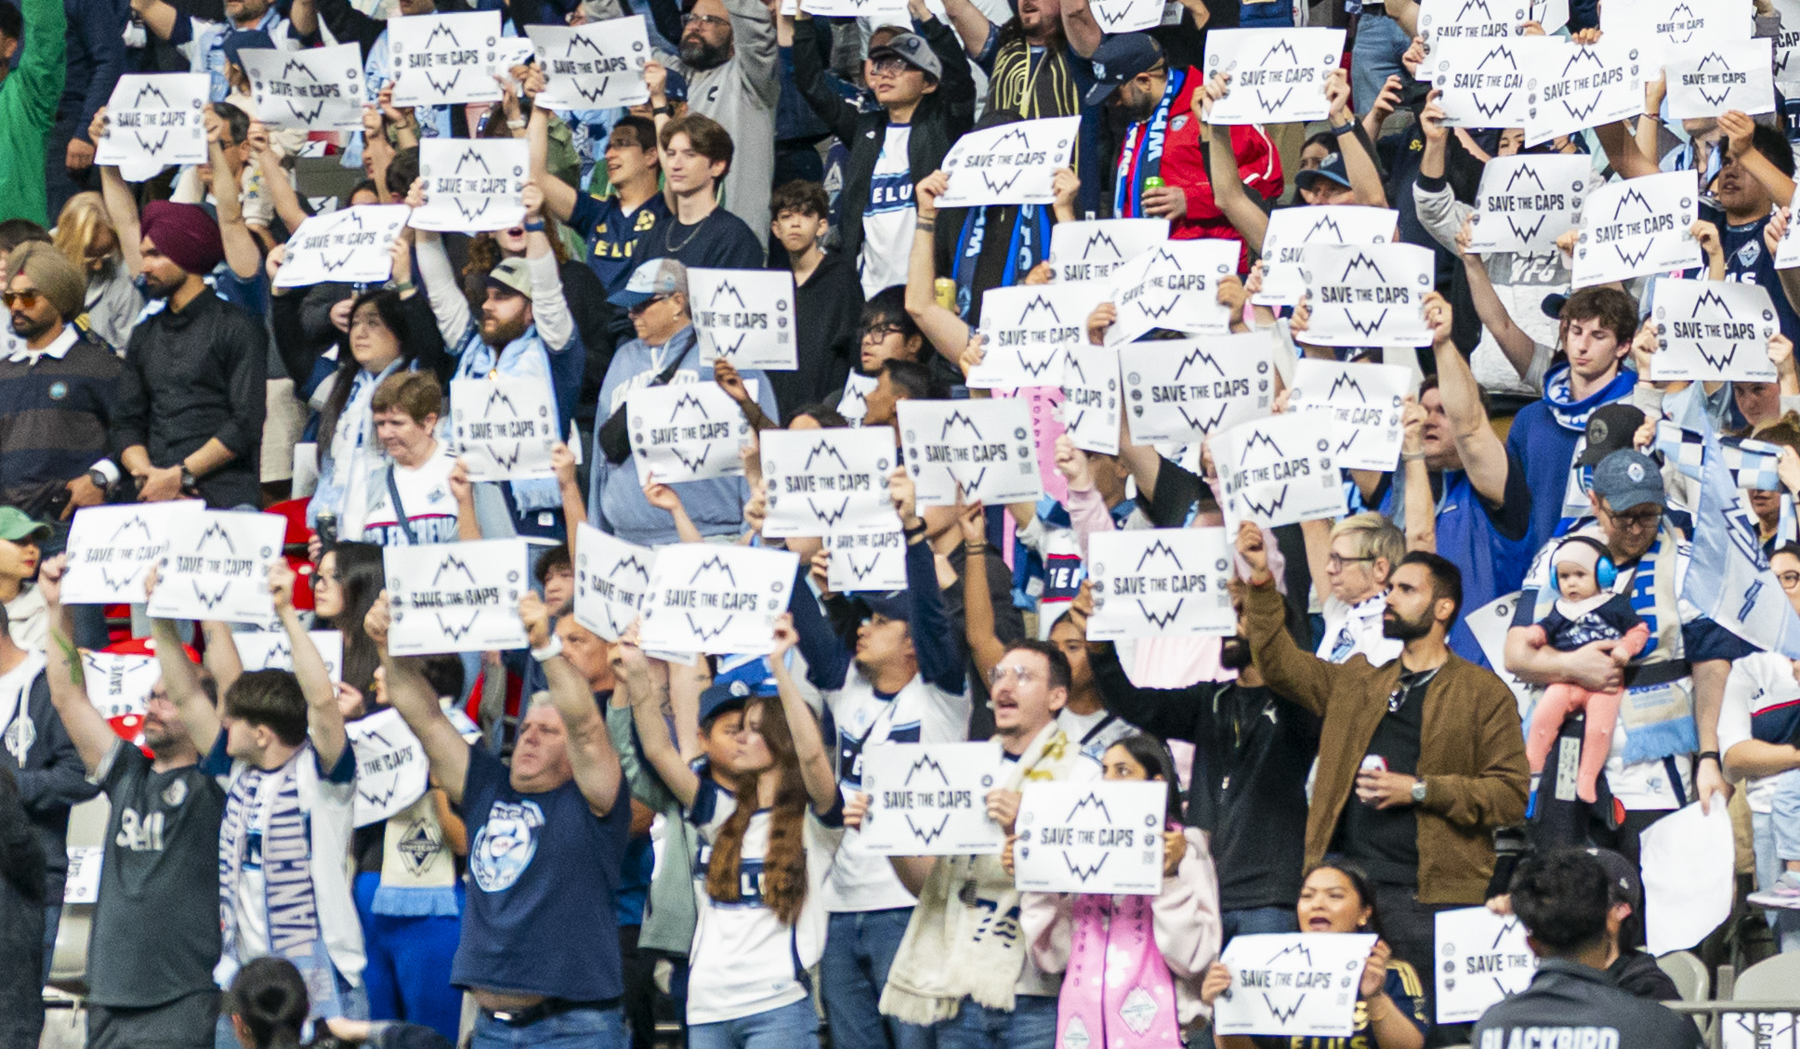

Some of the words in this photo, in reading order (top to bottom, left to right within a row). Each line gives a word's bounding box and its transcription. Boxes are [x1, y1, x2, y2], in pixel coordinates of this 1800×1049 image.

[409, 52, 432, 68] SAVE
[450, 49, 478, 65] CAPS
[1488, 195, 1514, 211] SAVE
[1517, 196, 1532, 209] THE
[1535, 193, 1564, 210] CAPS
[1321, 286, 1352, 303] SAVE
[1355, 288, 1372, 300] THE
[1375, 286, 1408, 303] CAPS
[1673, 321, 1703, 338] SAVE
[1704, 324, 1721, 336] THE
[1723, 322, 1755, 339] CAPS
[785, 475, 815, 492] SAVE
[838, 473, 869, 490] CAPS
[883, 790, 913, 808] SAVE
[938, 790, 971, 808] CAPS
[1040, 827, 1073, 845] SAVE
[1098, 828, 1133, 846] CAPS
